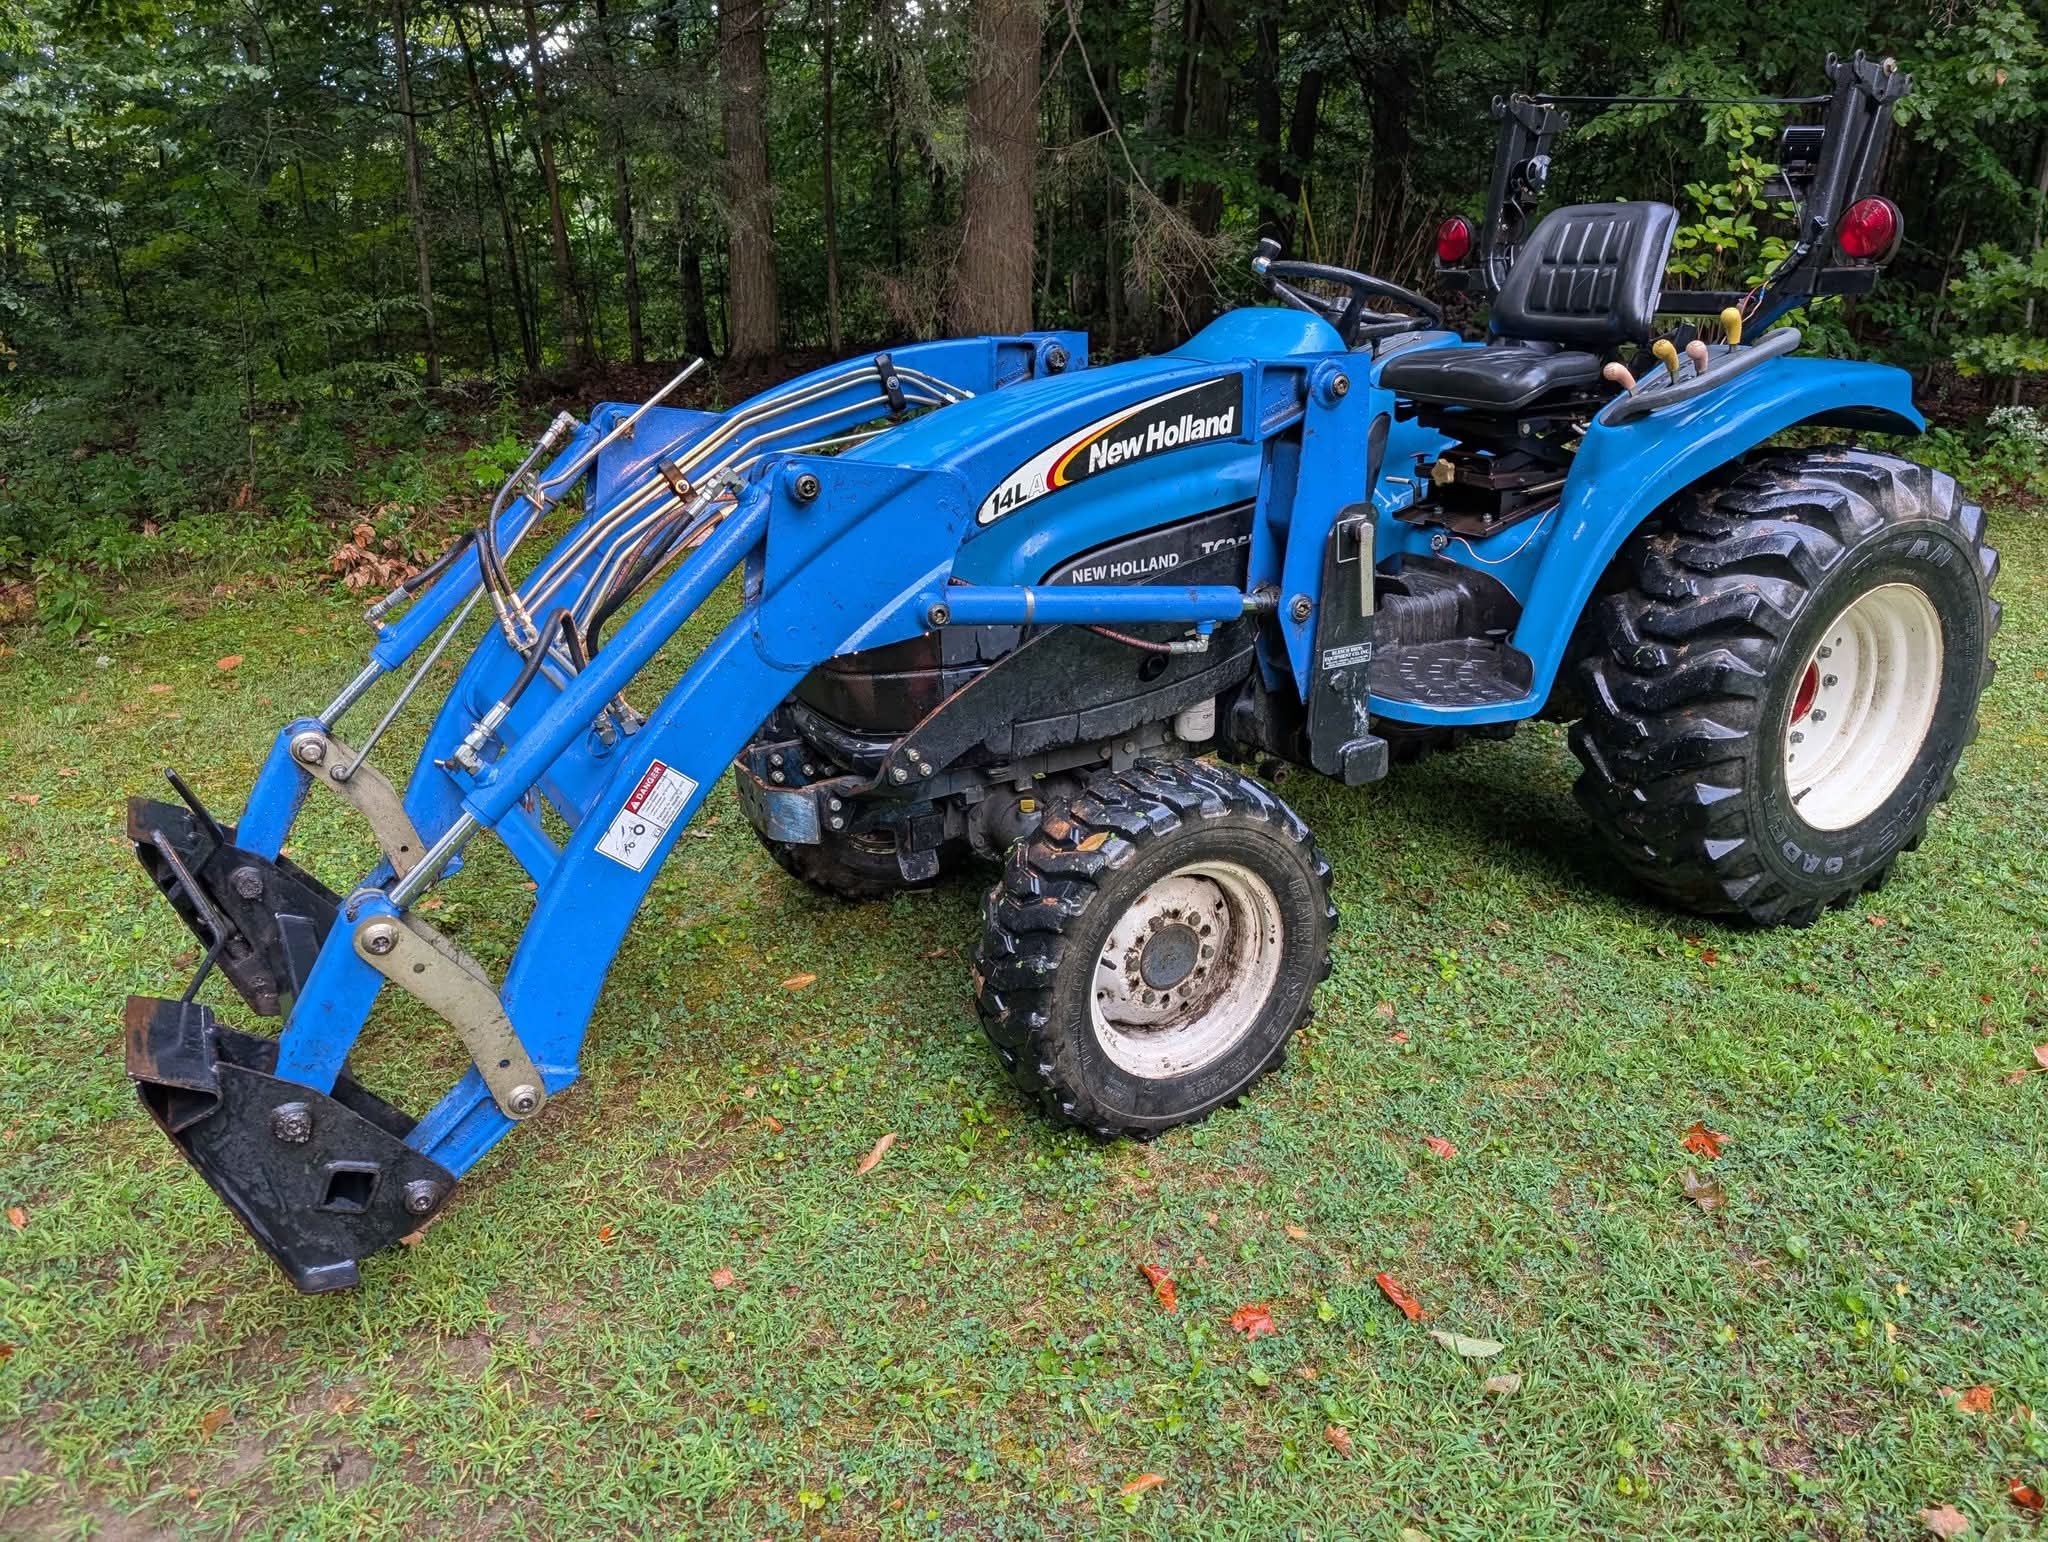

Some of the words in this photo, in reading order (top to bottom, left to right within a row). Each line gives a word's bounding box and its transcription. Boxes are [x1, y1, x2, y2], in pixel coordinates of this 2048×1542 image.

[1088, 433, 1145, 474] New
[1146, 406, 1235, 452] Holland
[992, 472, 1046, 516] 14LA
[1072, 565, 1107, 584] NEW
[1110, 552, 1180, 577] HOLLAND
[636, 767, 662, 801] DANGER
